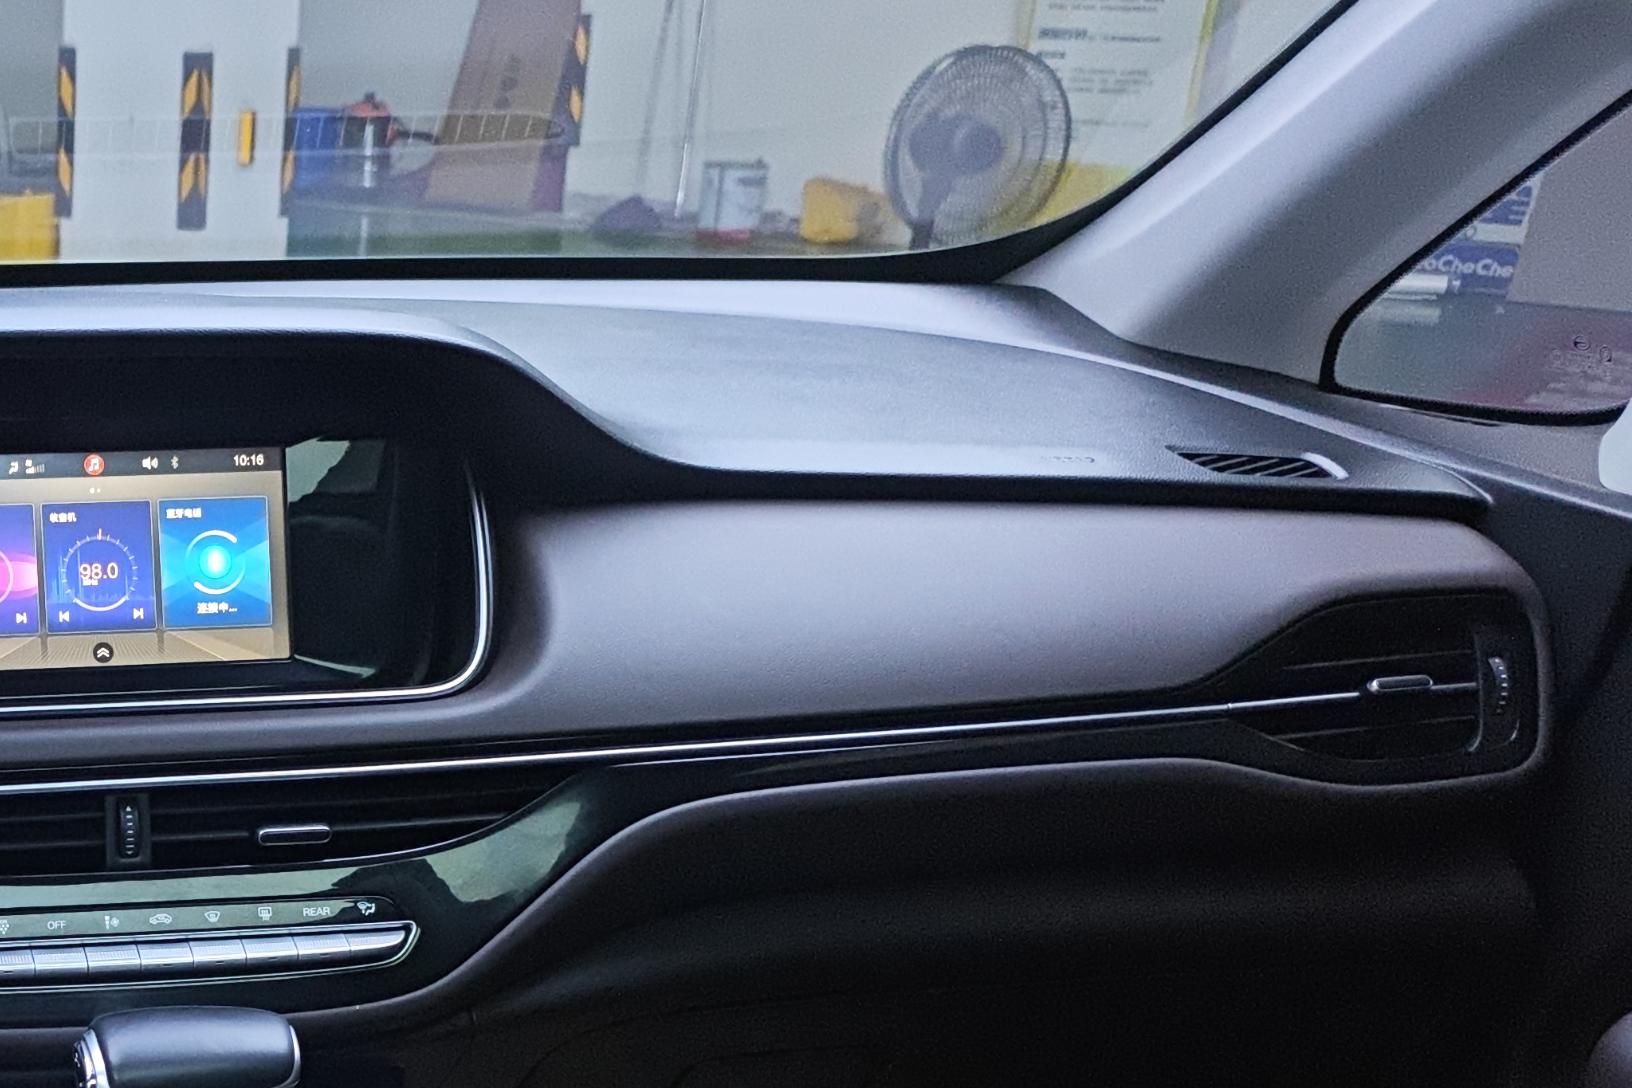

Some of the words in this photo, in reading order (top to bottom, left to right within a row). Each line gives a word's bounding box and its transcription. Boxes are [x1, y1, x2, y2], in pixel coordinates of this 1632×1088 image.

[233, 454, 264, 467] 10:16
[79, 562, 119, 580] 98.0
[303, 907, 330, 917] REAR
[47, 920, 67, 930] OFF
